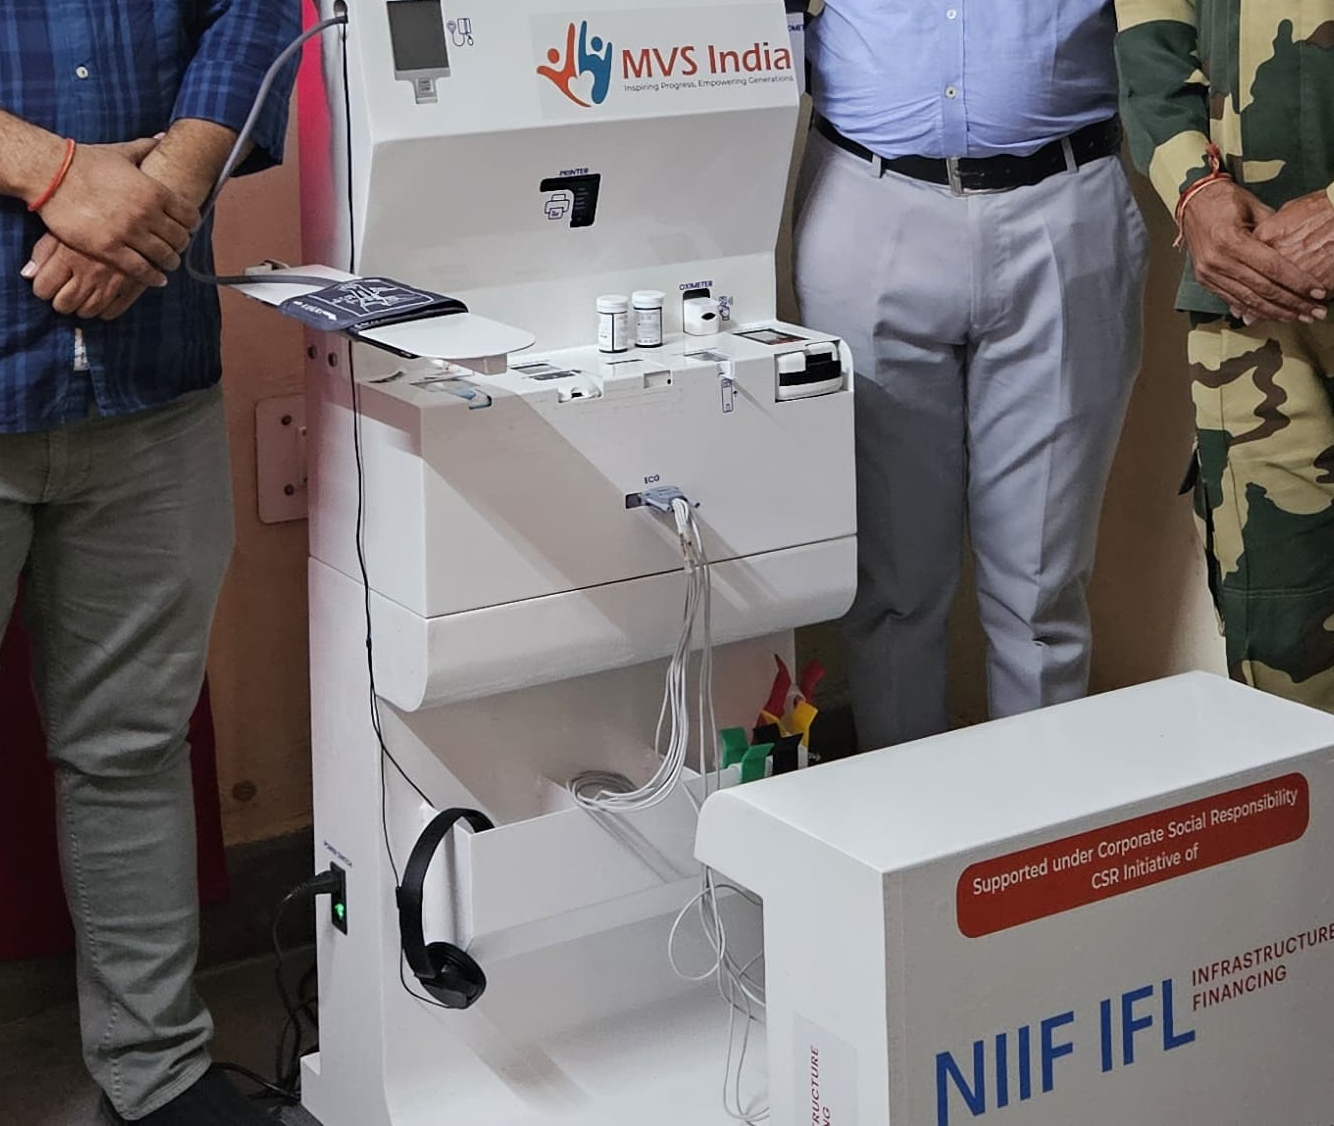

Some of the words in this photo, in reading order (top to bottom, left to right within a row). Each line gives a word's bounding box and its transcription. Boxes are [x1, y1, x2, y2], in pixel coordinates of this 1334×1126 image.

[622, 45, 698, 80] MVS
[707, 41, 792, 75] India
[624, 82, 660, 92] Inspiring
[661, 80, 698, 91] Progress,
[698, 78, 748, 88] Empowering
[748, 75, 794, 84] Generations
[559, 168, 589, 176] PRINTER
[679, 280, 713, 290] OXIMETER
[972, 858, 1049, 895] Supported
[1053, 847, 1094, 873] under
[1098, 827, 1165, 859] Corporate
[1167, 812, 1208, 839] Social
[1210, 789, 1299, 827] Responsibility
[1091, 871, 1120, 891] CSR
[1123, 852, 1181, 882] Initiative
[1185, 843, 1200, 864] of
[1192, 964, 1287, 1012] FINANCING
[935, 1010, 1075, 1126] NIIF
[1099, 978, 1196, 1074] IFL
